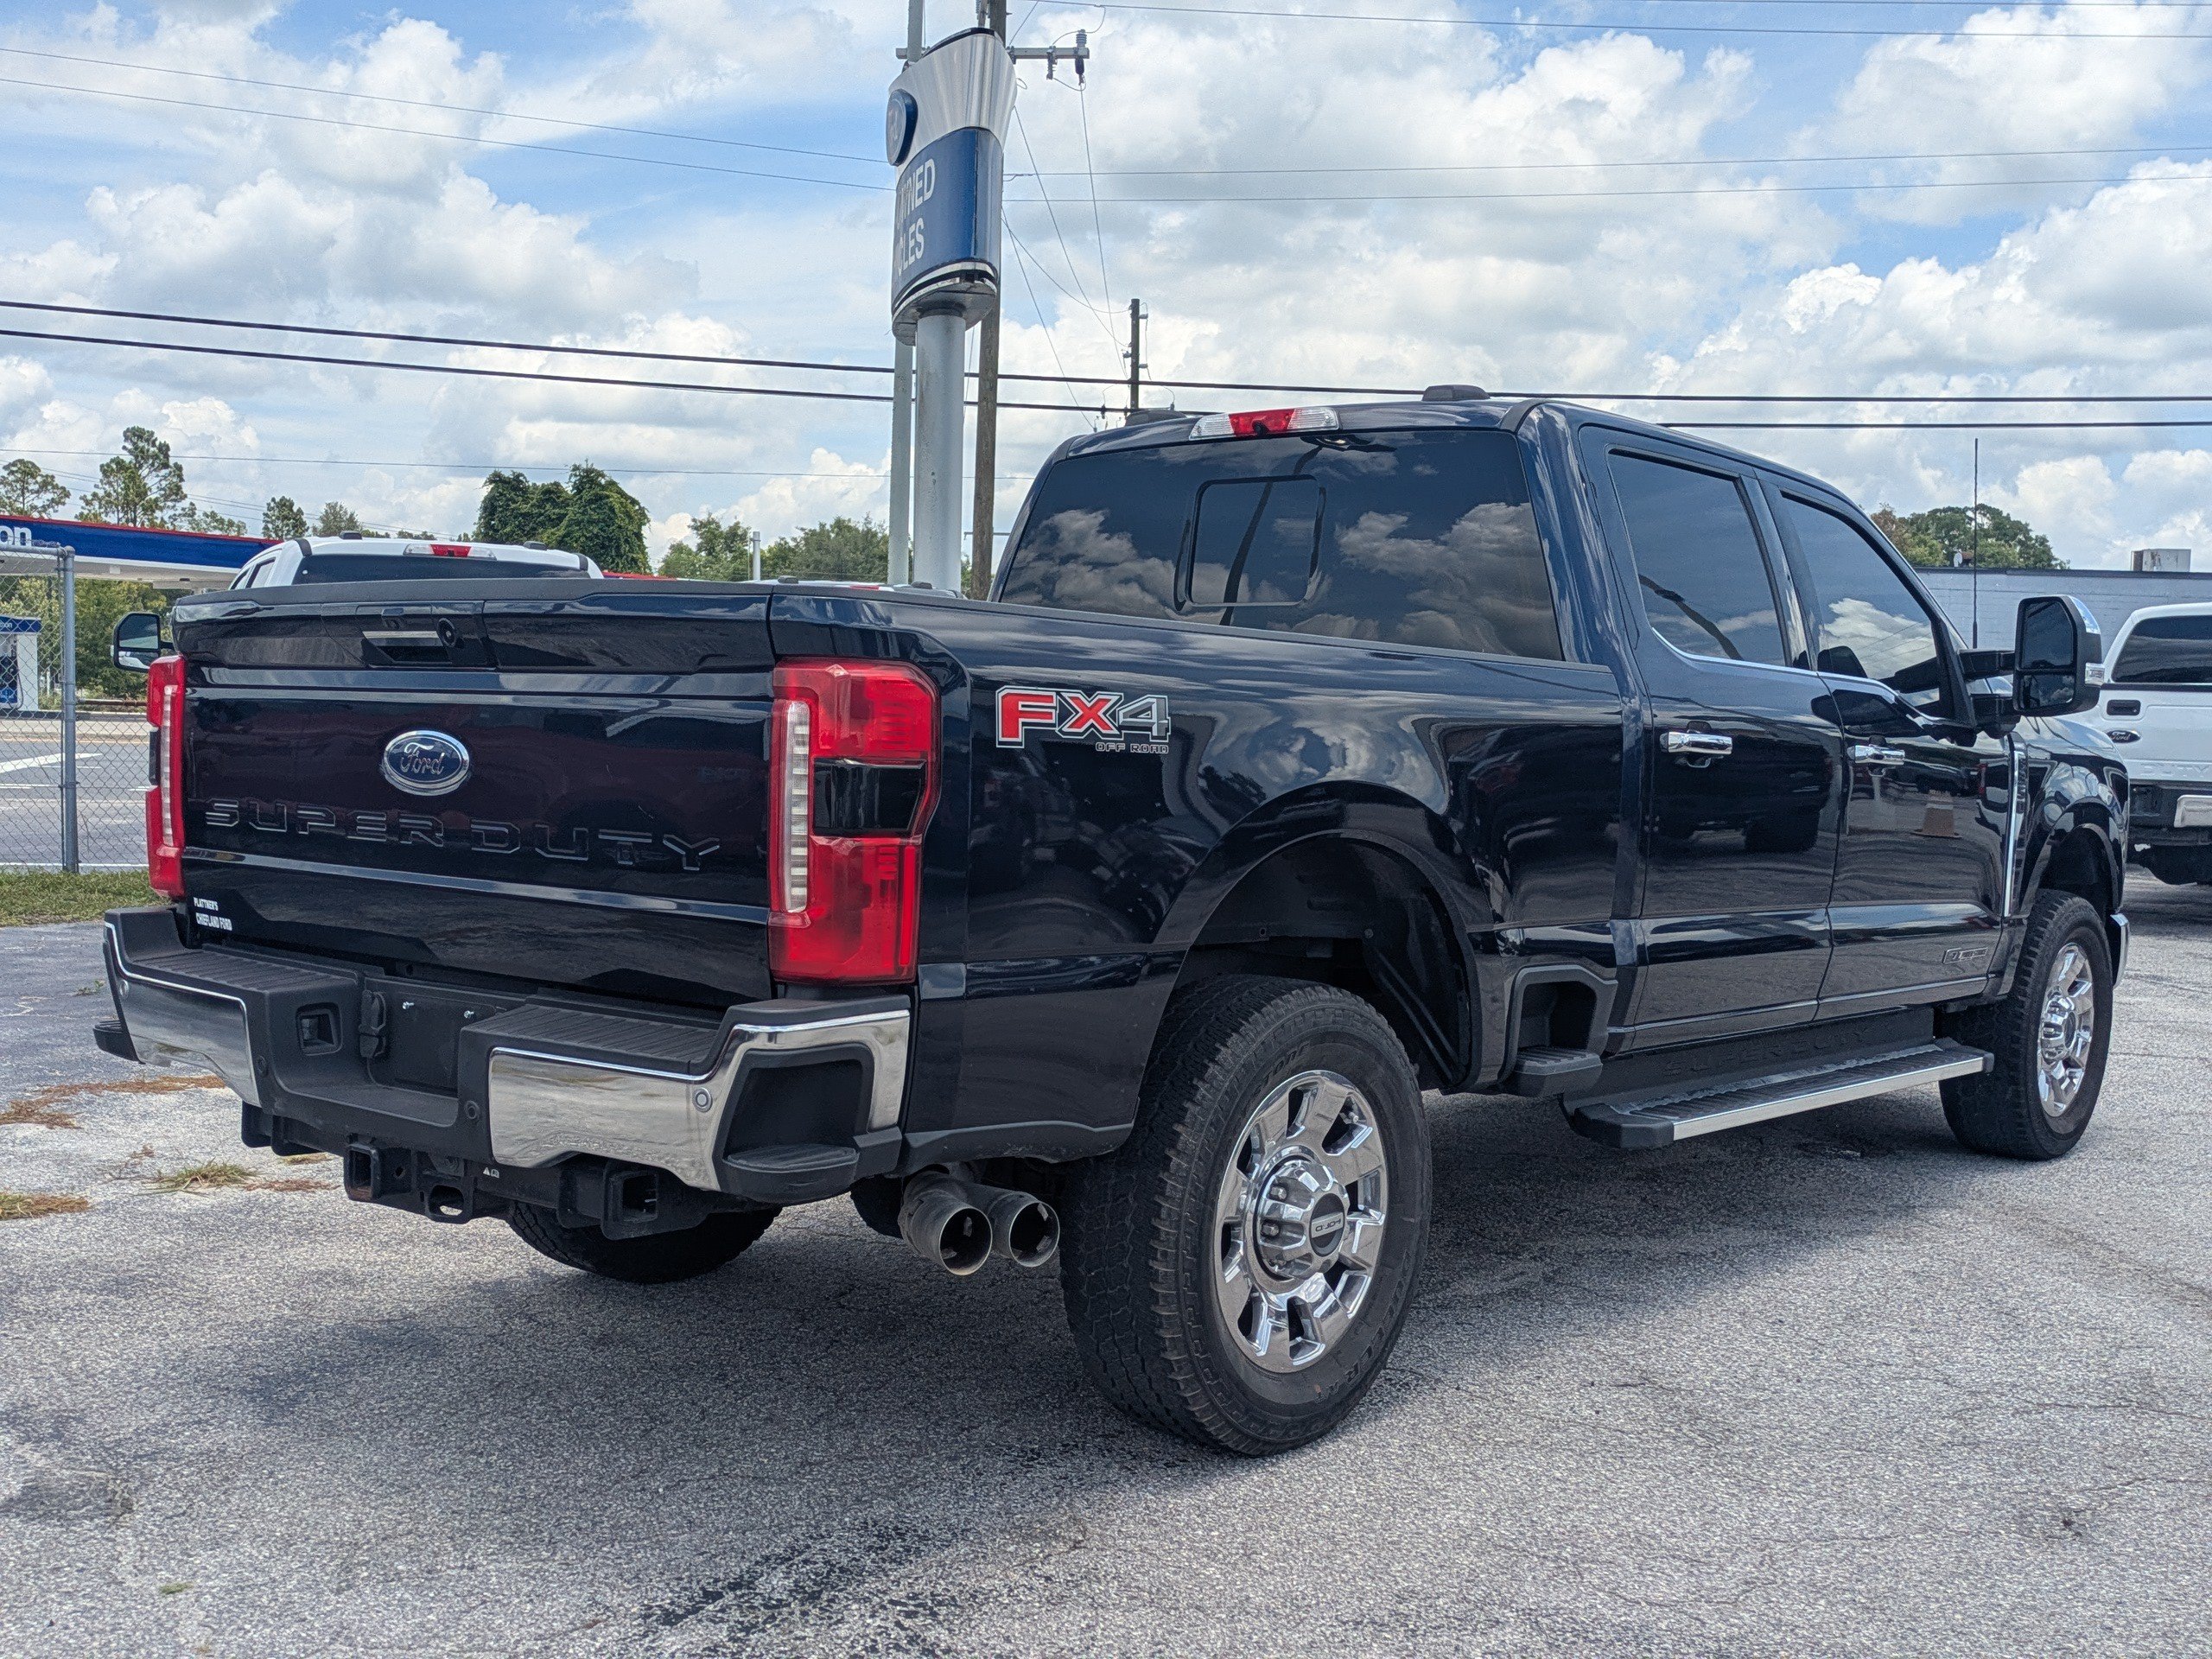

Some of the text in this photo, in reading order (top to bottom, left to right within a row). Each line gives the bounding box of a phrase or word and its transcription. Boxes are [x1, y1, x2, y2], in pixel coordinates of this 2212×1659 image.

[995, 685, 1171, 748] FX4
[399, 741, 446, 775] Ford
[1096, 741, 1170, 754] OFF ROAD
[205, 798, 721, 871] SUPER DUTY
[219, 917, 233, 931] FORD
